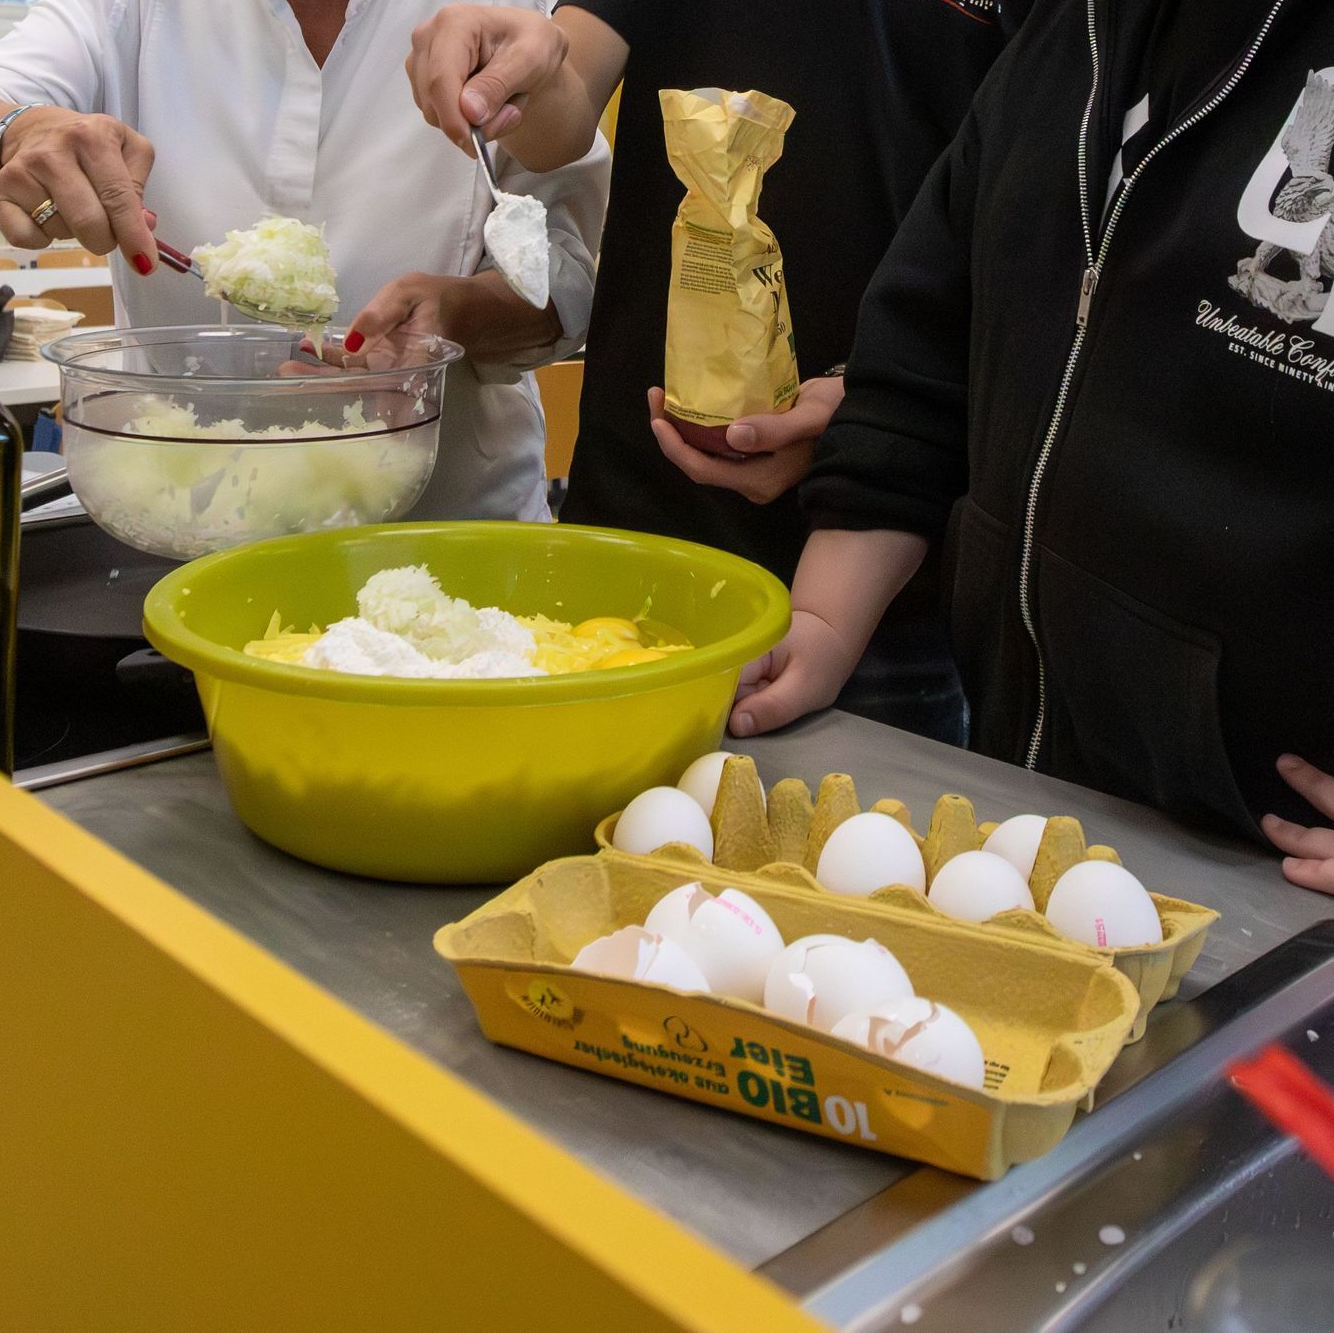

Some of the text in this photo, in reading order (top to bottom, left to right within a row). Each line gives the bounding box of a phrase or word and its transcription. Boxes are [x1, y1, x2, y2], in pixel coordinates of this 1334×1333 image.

[1195, 299, 1286, 356] Unbeatable
[1228, 342, 1247, 357] EST.
[1249, 351, 1276, 369] SINCE
[1278, 362, 1315, 384] NINETY
[573, 1039, 730, 1095] aus ökologischer
[621, 1034, 726, 1078] Erzeugung
[730, 1037, 815, 1086] Eier
[737, 1070, 878, 1142] 10 BIO
